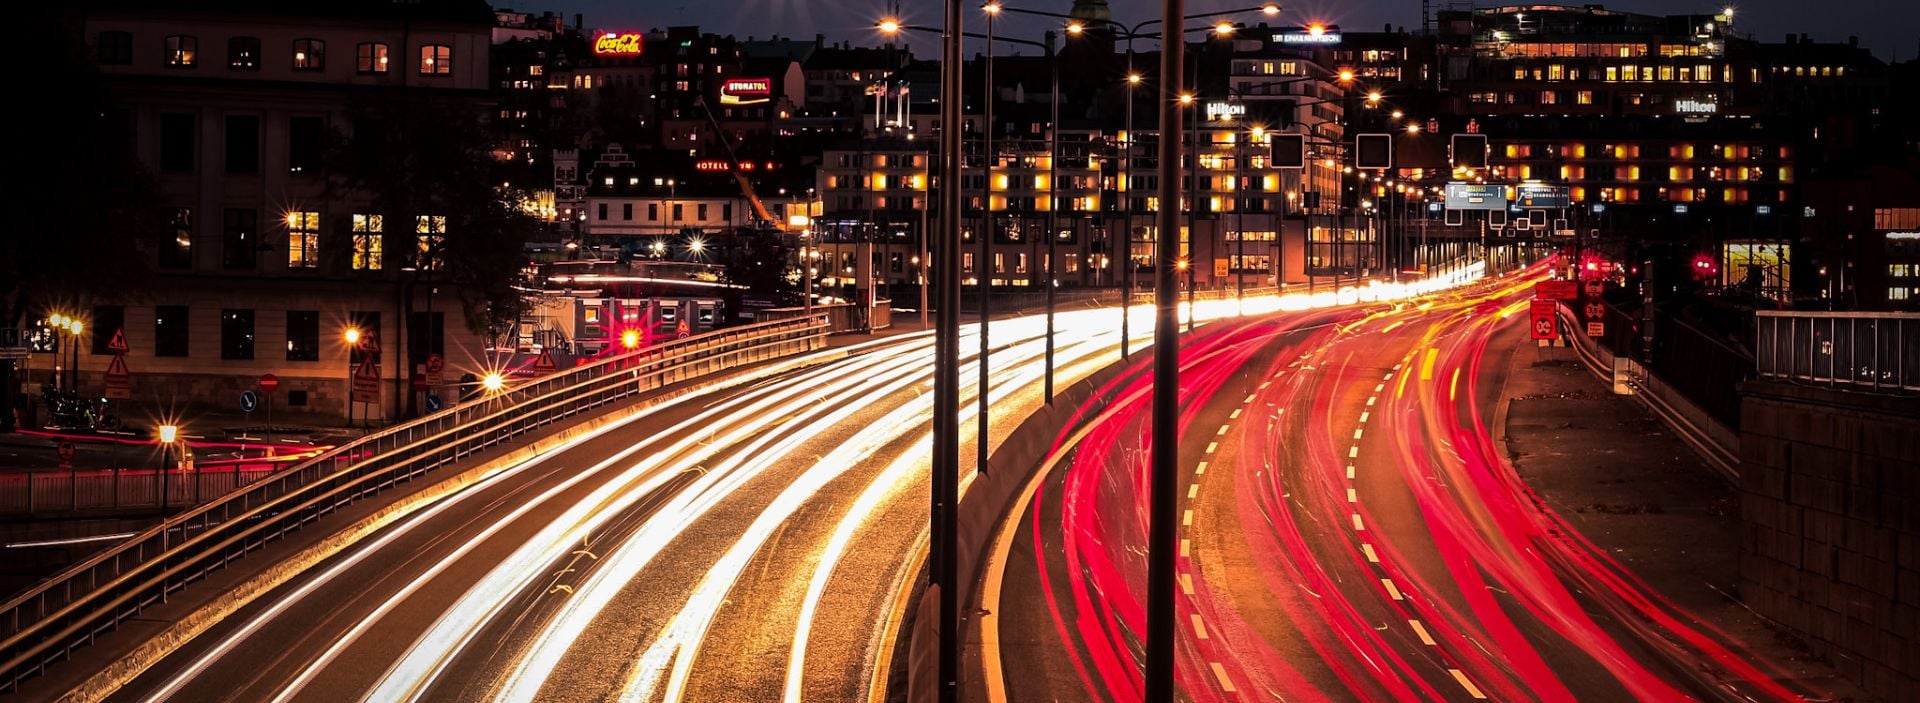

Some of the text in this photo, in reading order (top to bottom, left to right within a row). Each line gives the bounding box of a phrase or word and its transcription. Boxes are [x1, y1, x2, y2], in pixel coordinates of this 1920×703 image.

[729, 82, 767, 91] STOMATOL
[1207, 102, 1245, 115] Hilton
[1675, 100, 1716, 113] Hilton
